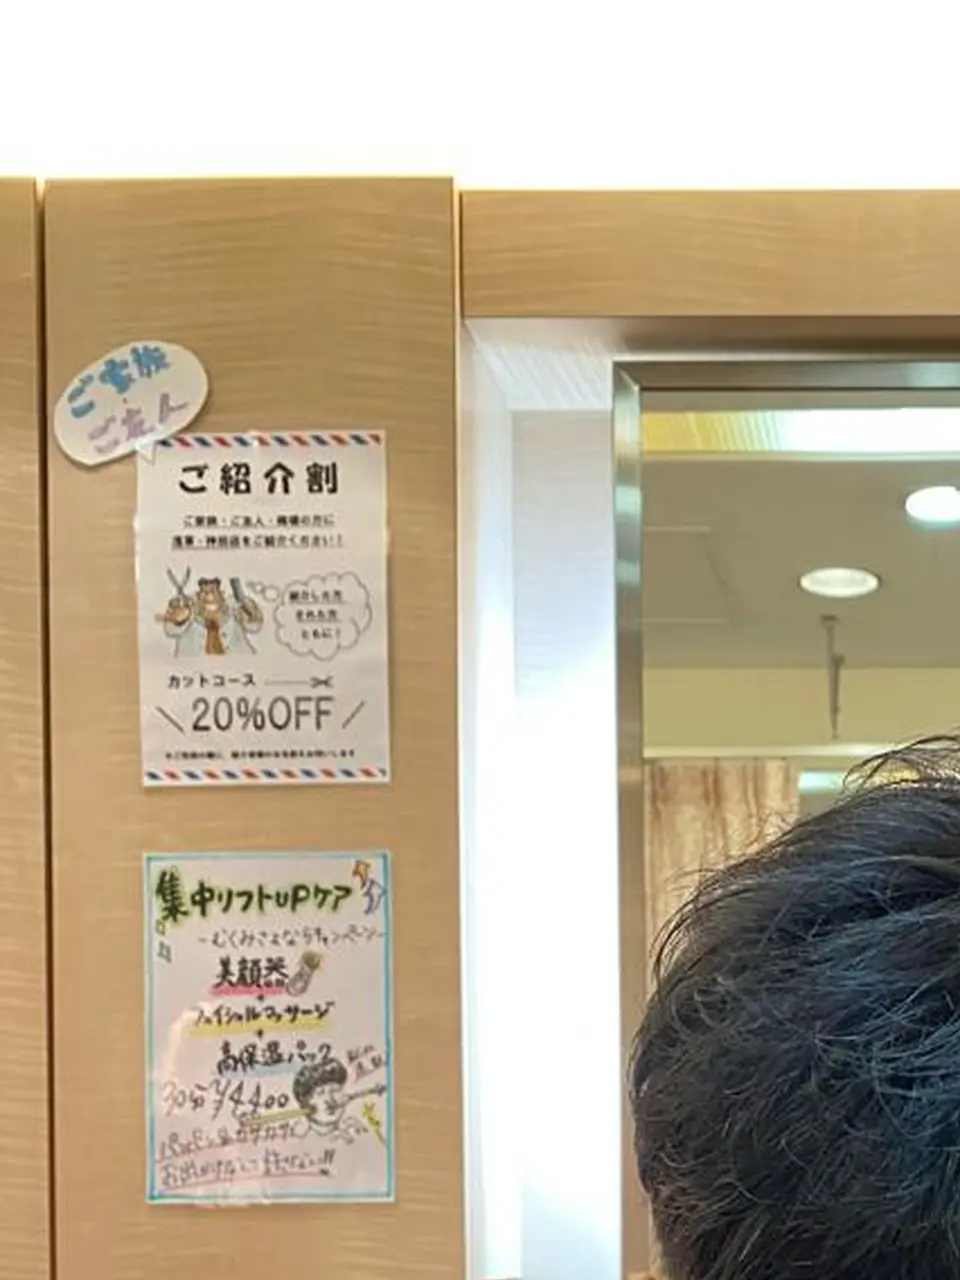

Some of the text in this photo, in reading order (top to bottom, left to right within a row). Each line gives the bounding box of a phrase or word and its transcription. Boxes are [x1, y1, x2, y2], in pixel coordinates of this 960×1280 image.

[178, 462, 339, 496] ご紹介割
[167, 673, 257, 689] カットコース
[191, 695, 335, 732] 20%OFF
[214, 955, 290, 988] 美顔器
